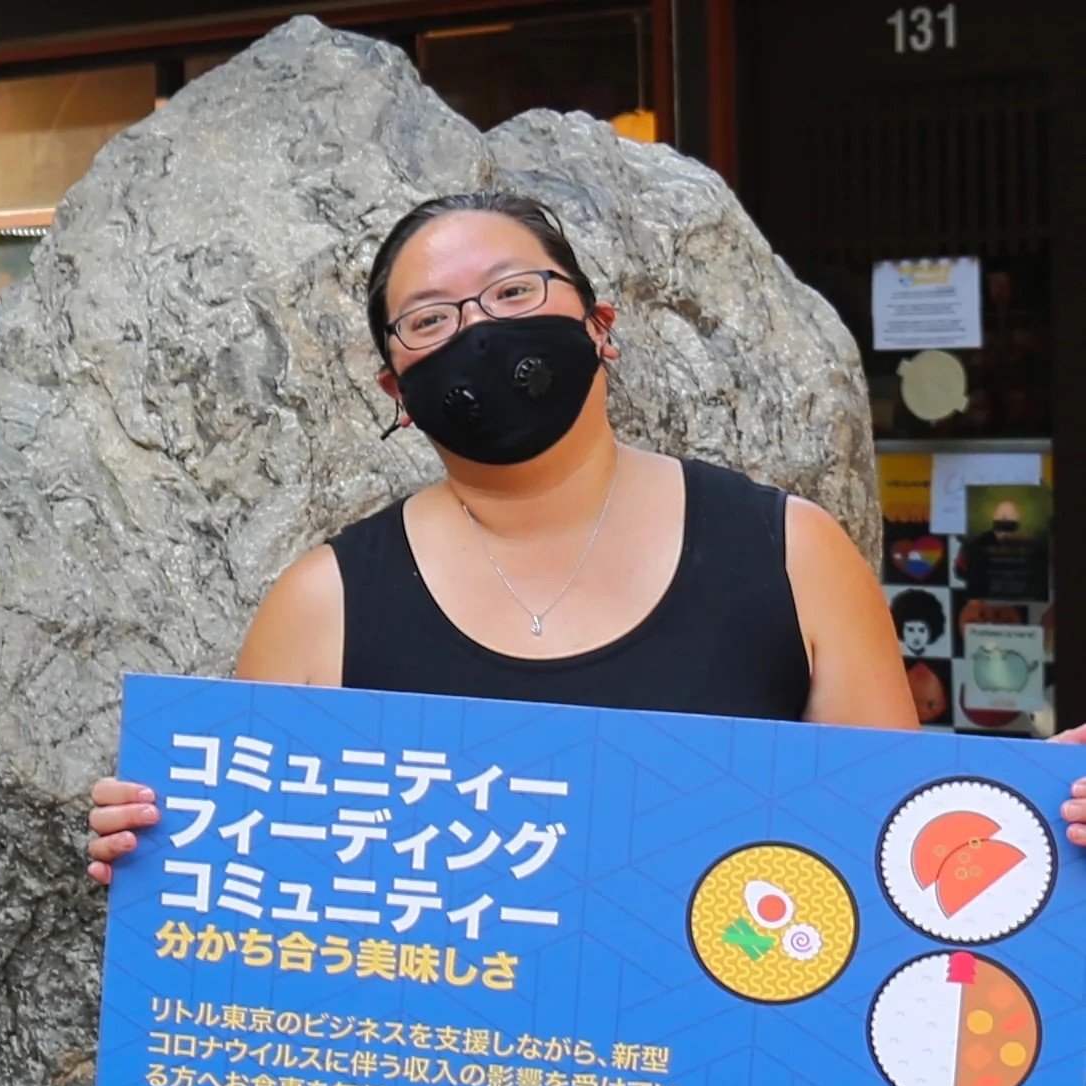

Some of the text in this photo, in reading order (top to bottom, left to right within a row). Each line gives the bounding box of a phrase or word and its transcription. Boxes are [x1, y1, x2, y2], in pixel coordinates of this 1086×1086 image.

[886, 3, 957, 53] 131
[169, 733, 568, 811] コミュニティー
[165, 797, 567, 880] フィーディング
[160, 859, 559, 939] コミュニティー
[154, 920, 519, 990] 分かち合う美味しさ
[150, 996, 670, 1074] リトル東京のビジネスを支援しながら、新型
